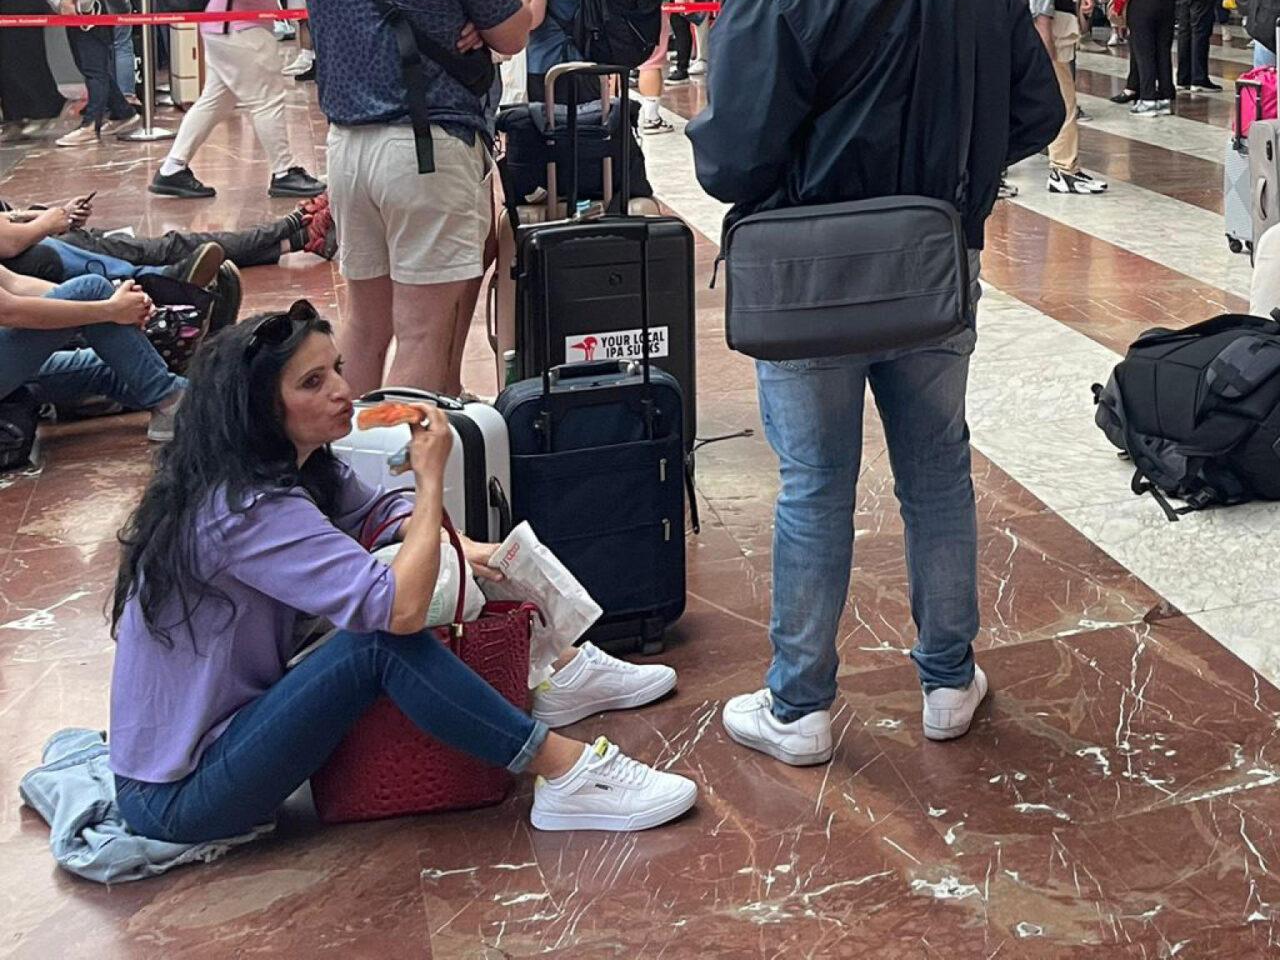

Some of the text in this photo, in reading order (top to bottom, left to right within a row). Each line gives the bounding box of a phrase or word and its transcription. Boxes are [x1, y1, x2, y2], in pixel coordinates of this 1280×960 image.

[600, 331, 665, 348] YOUR LOAL
[606, 342, 660, 358] IPA SUKS
